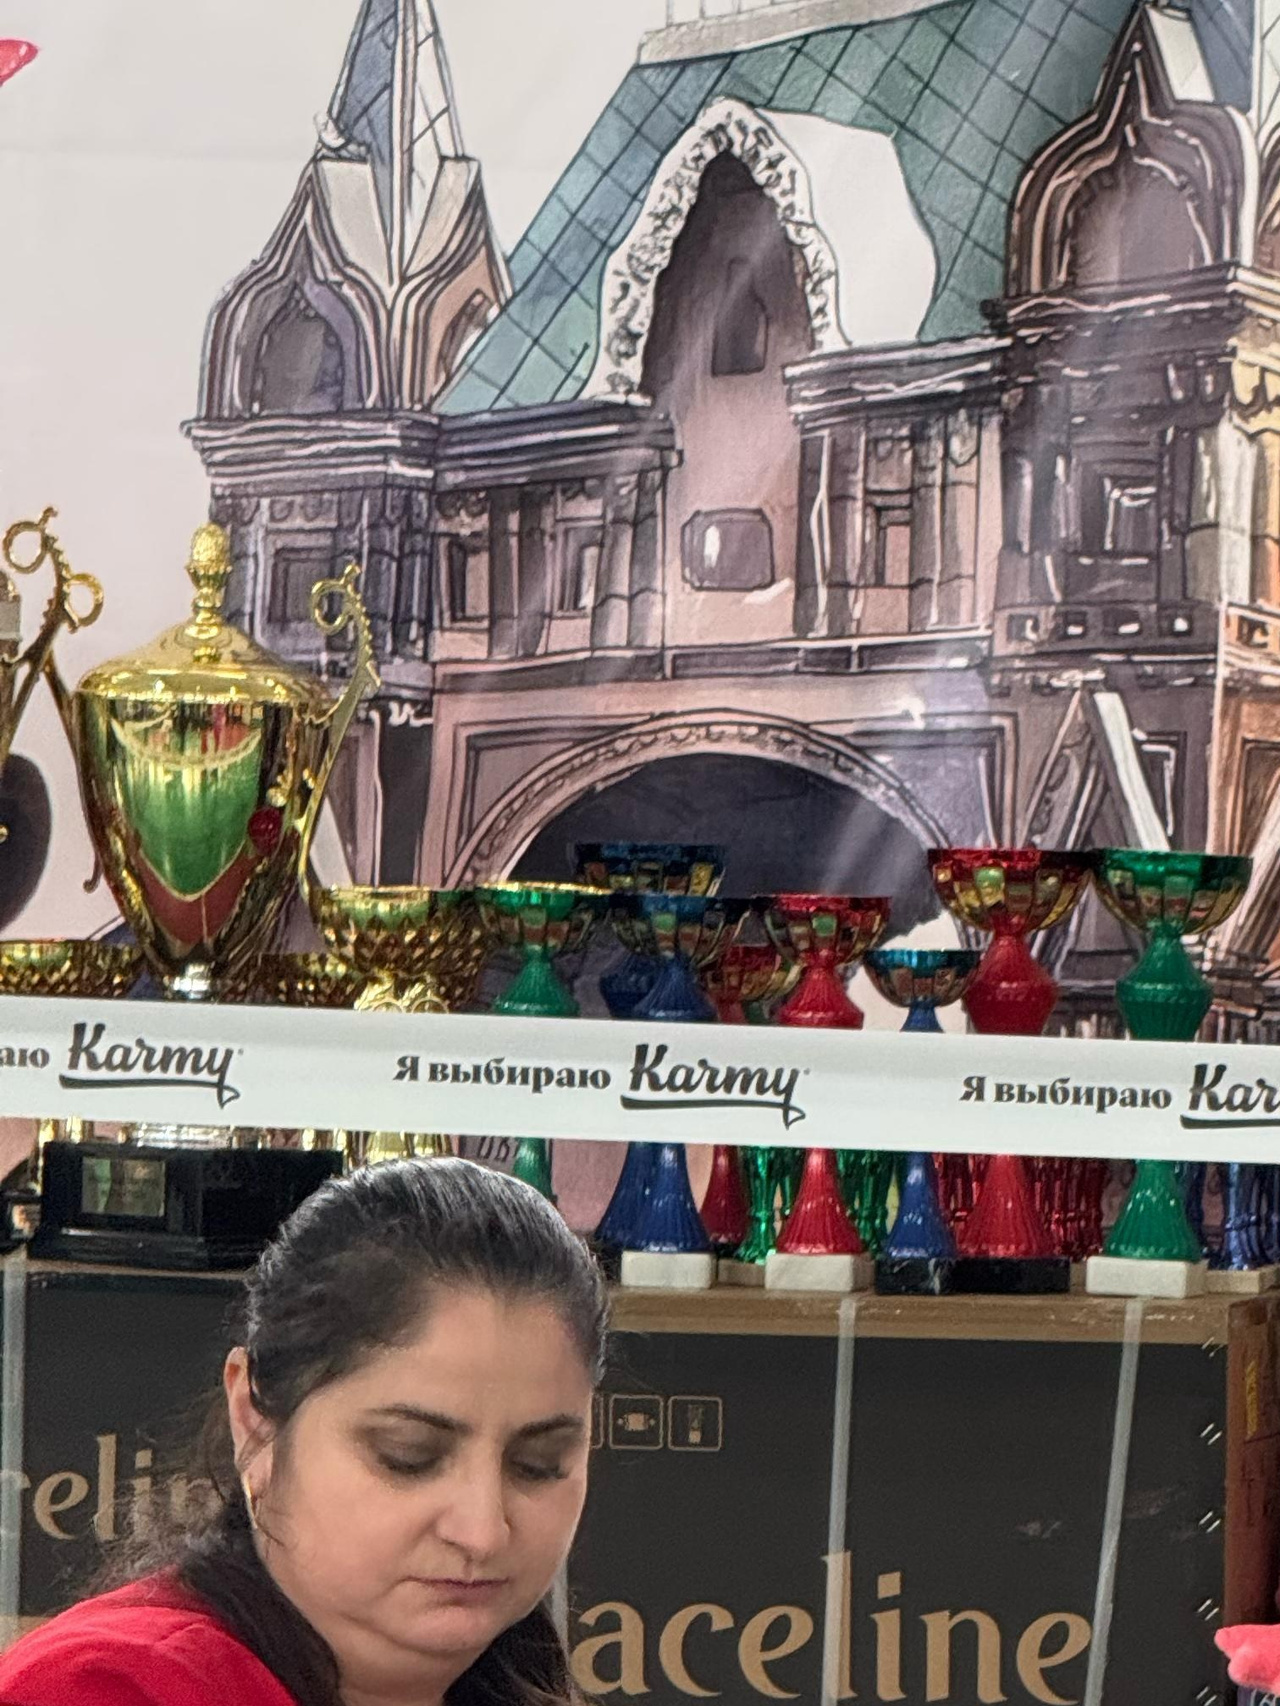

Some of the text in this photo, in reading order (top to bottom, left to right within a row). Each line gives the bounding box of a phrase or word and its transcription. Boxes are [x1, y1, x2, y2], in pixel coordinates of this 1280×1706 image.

[59, 1021, 240, 1108] Karmy
[393, 1043, 806, 1131] Я выбираю Karmy
[959, 1074, 986, 1102] Я
[993, 1076, 1172, 1113] выбираю
